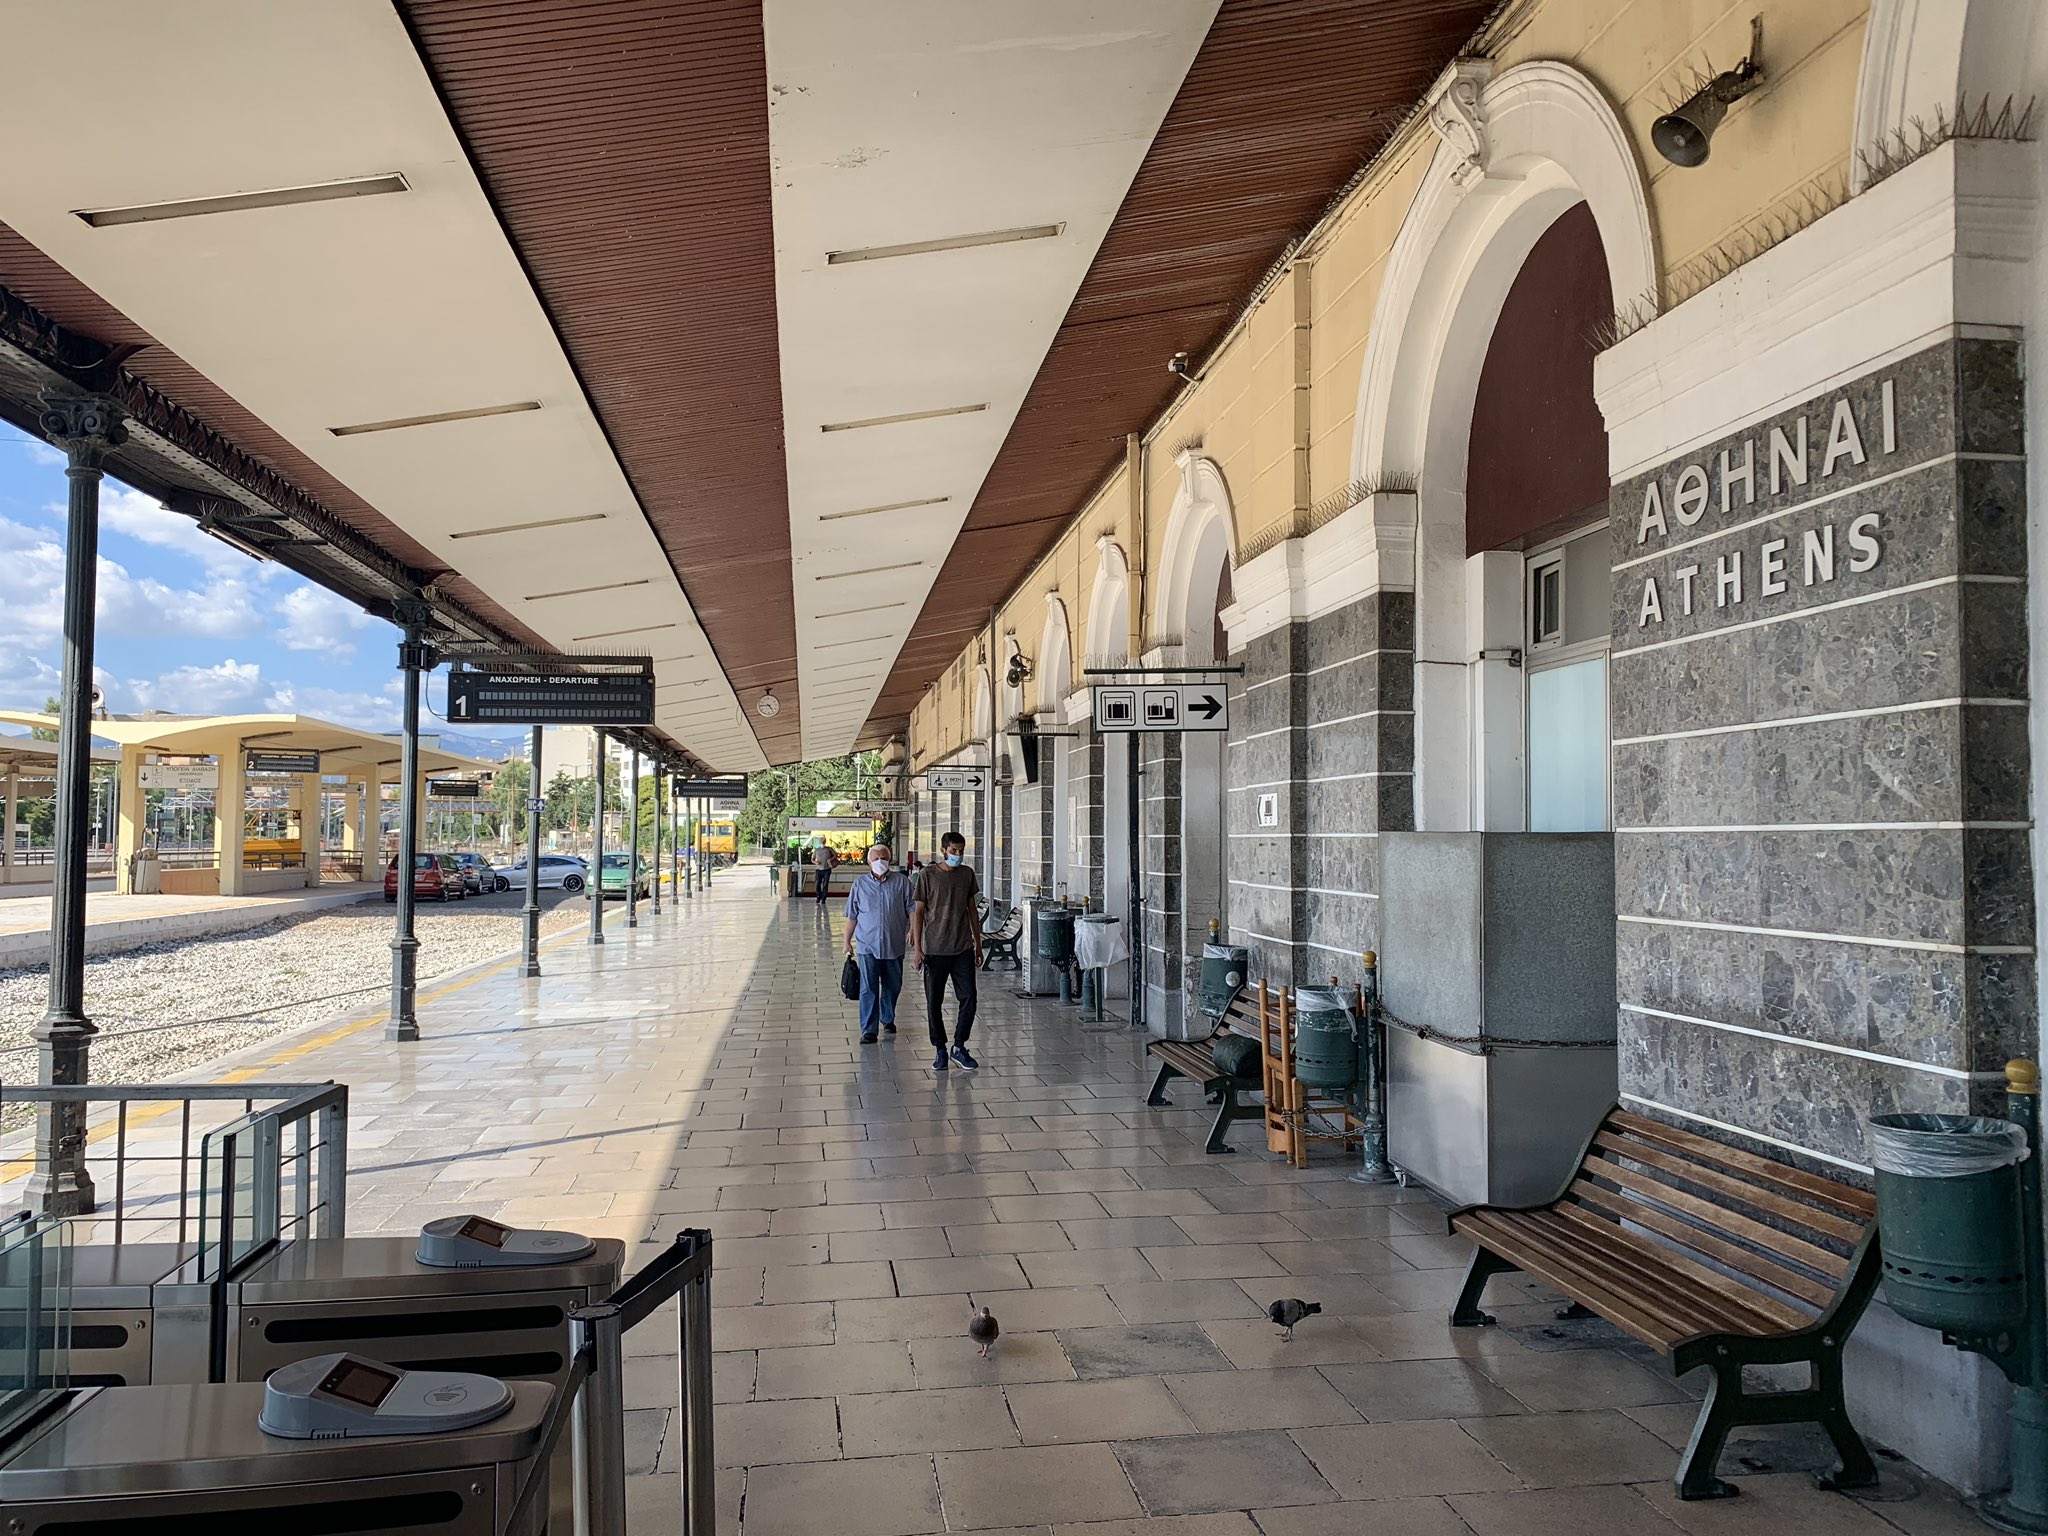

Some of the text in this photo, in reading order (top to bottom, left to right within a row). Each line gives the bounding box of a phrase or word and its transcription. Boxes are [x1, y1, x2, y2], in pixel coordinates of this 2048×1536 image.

[1637, 379, 1896, 545] ΑΘΗΝΑΙ
[1639, 512, 1882, 628] ATHENS
[488, 676, 541, 684] ΑΝΑΧΩΡΗΣΗ
[549, 677, 599, 685] DEPARTURE
[455, 695, 467, 716] 1
[248, 760, 254, 769] 2
[674, 786, 680, 796] 1
